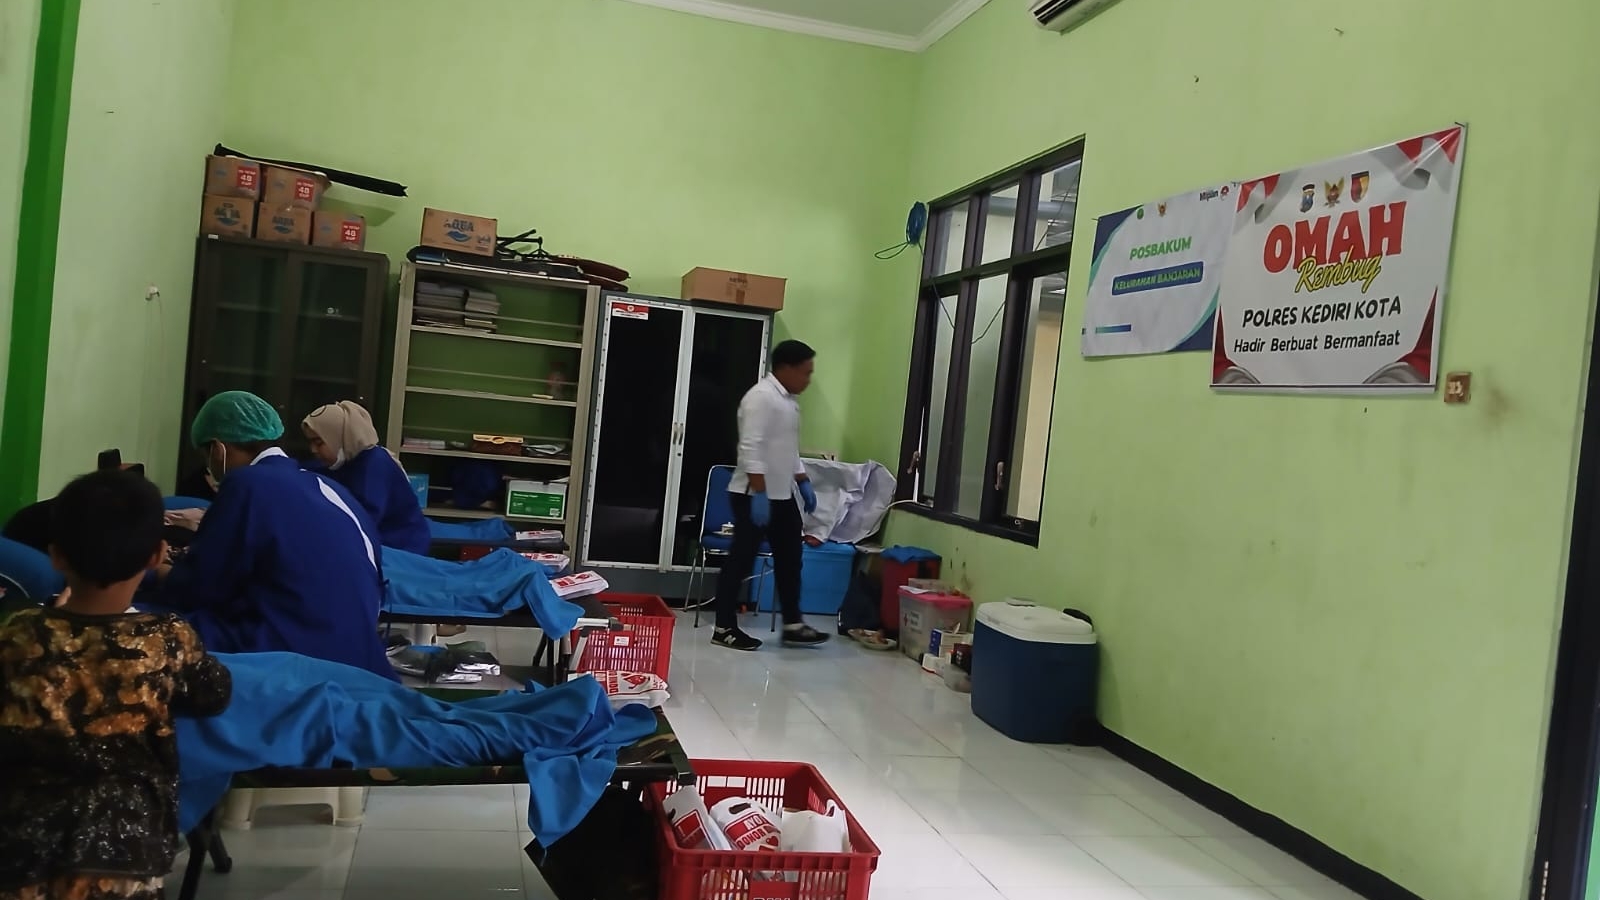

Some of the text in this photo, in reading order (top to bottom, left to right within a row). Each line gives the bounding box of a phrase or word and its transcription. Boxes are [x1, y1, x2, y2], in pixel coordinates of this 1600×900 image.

[240, 174, 253, 182] 48
[298, 186, 310, 194] 48
[344, 229, 356, 237] 48
[443, 218, 475, 233] AQUA
[1129, 236, 1193, 261] POSBAKUM
[1263, 201, 1407, 274] OMAH
[1295, 245, 1383, 293] Rembug
[1114, 275, 1156, 291] KELURAHAN
[1242, 295, 1401, 329] POLRES KEDIRI KOTA
[1234, 329, 1400, 353] Hadir Berbuat Bermanfaat
[736, 828, 766, 851] DONOR
